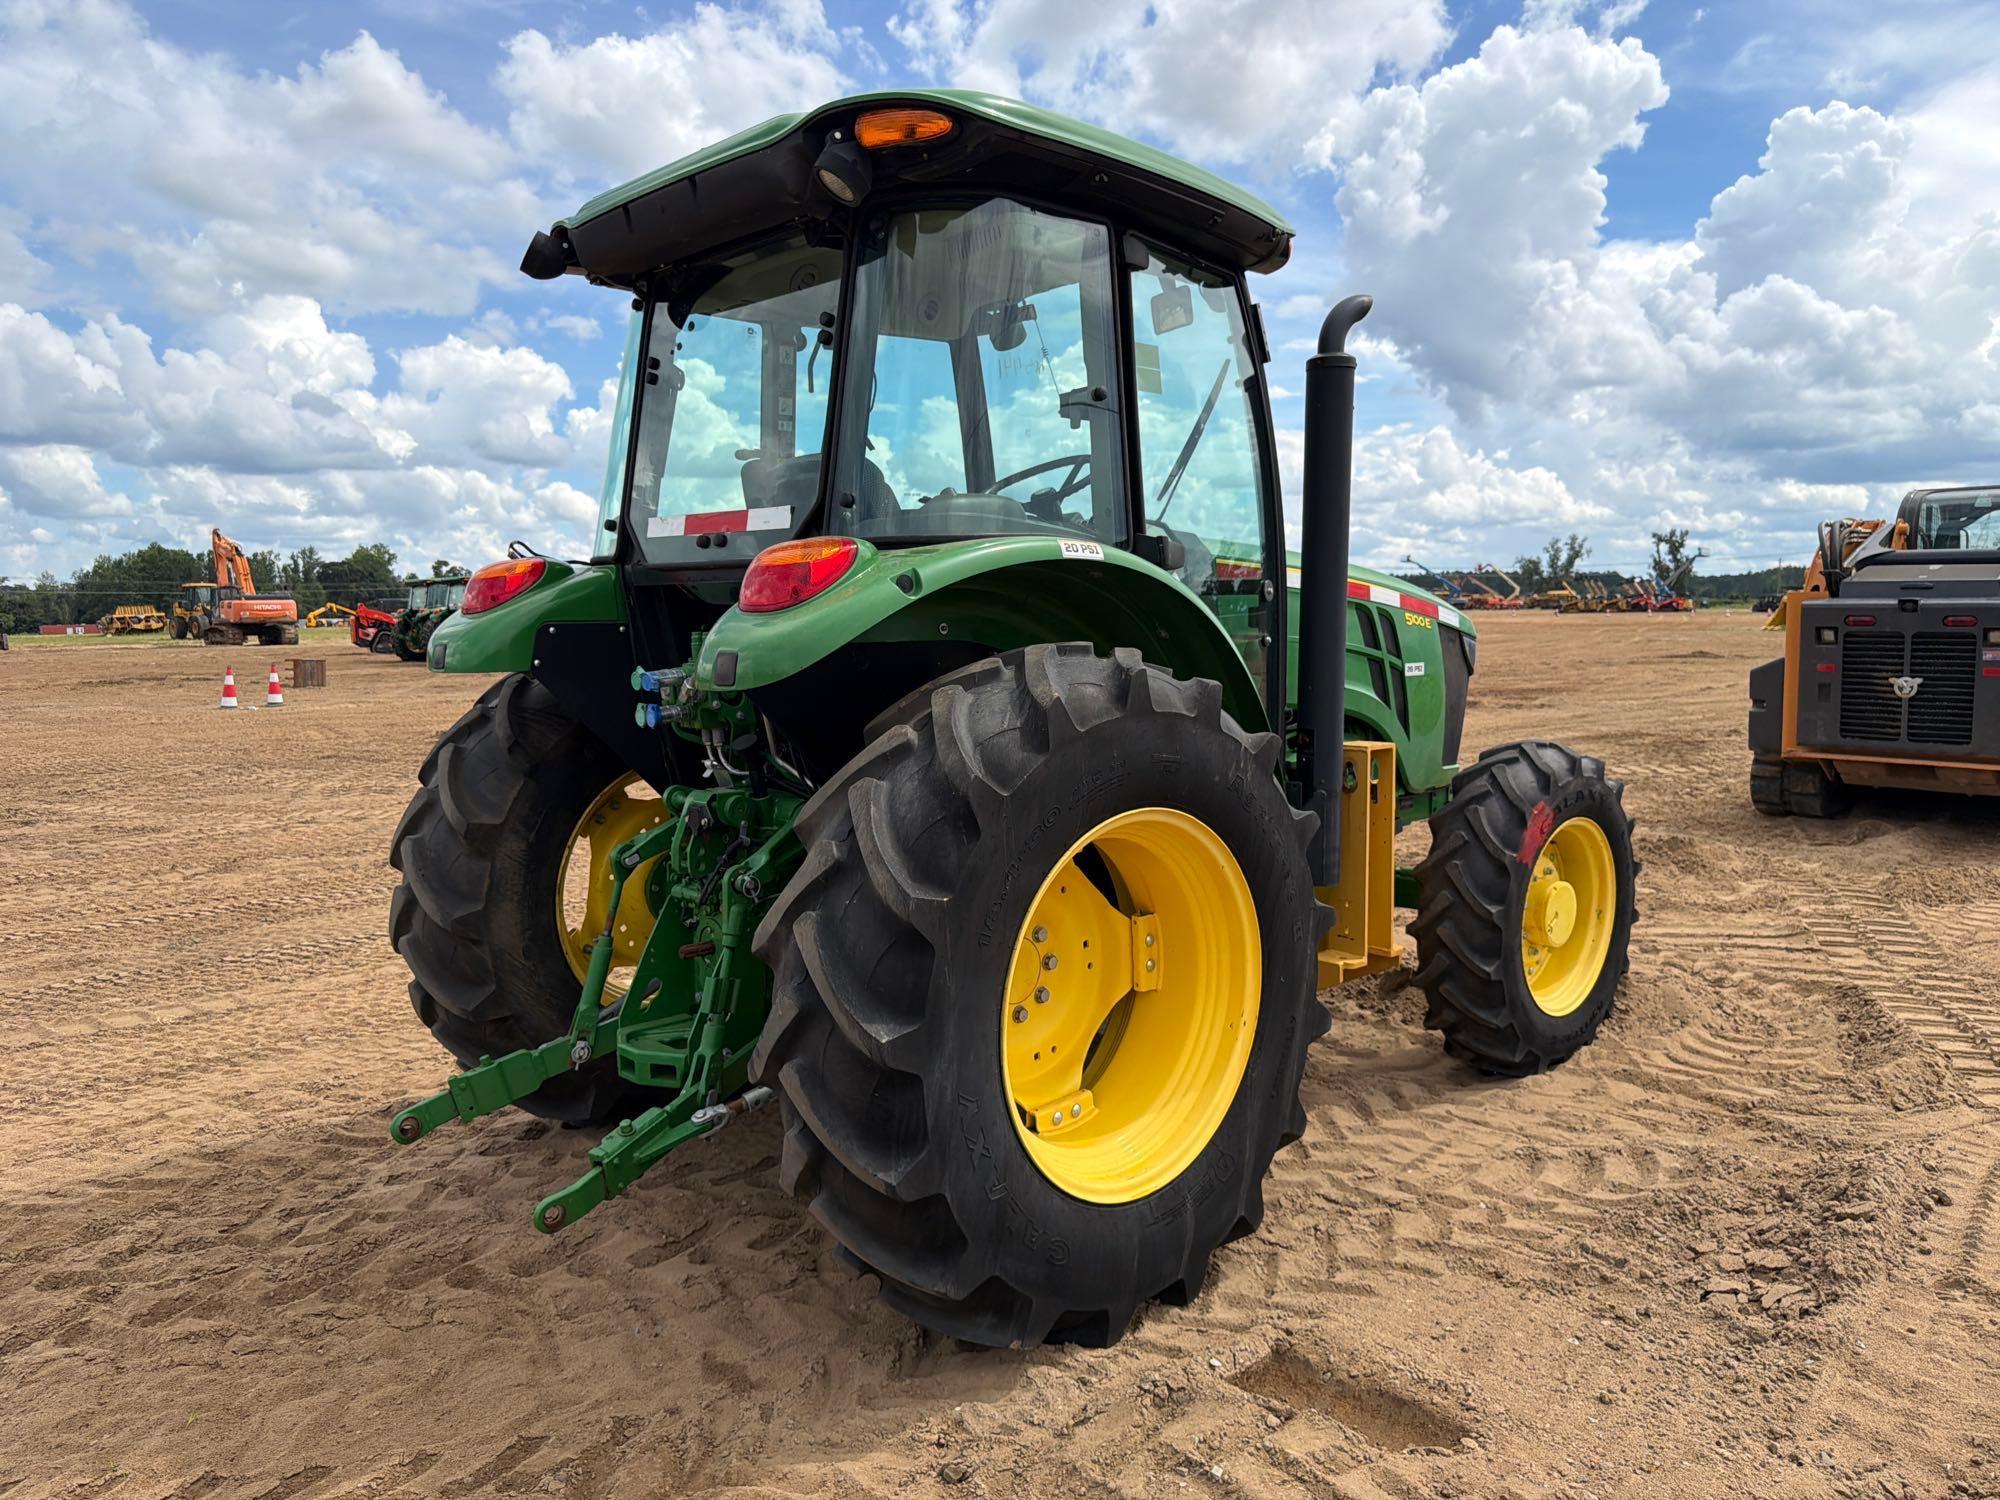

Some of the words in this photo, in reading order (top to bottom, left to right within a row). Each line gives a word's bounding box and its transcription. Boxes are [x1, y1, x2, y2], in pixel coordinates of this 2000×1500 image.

[1064, 543, 1078, 553] 20
[1080, 543, 1100, 555] PSI
[957, 1092, 1072, 1266] GALAXY
